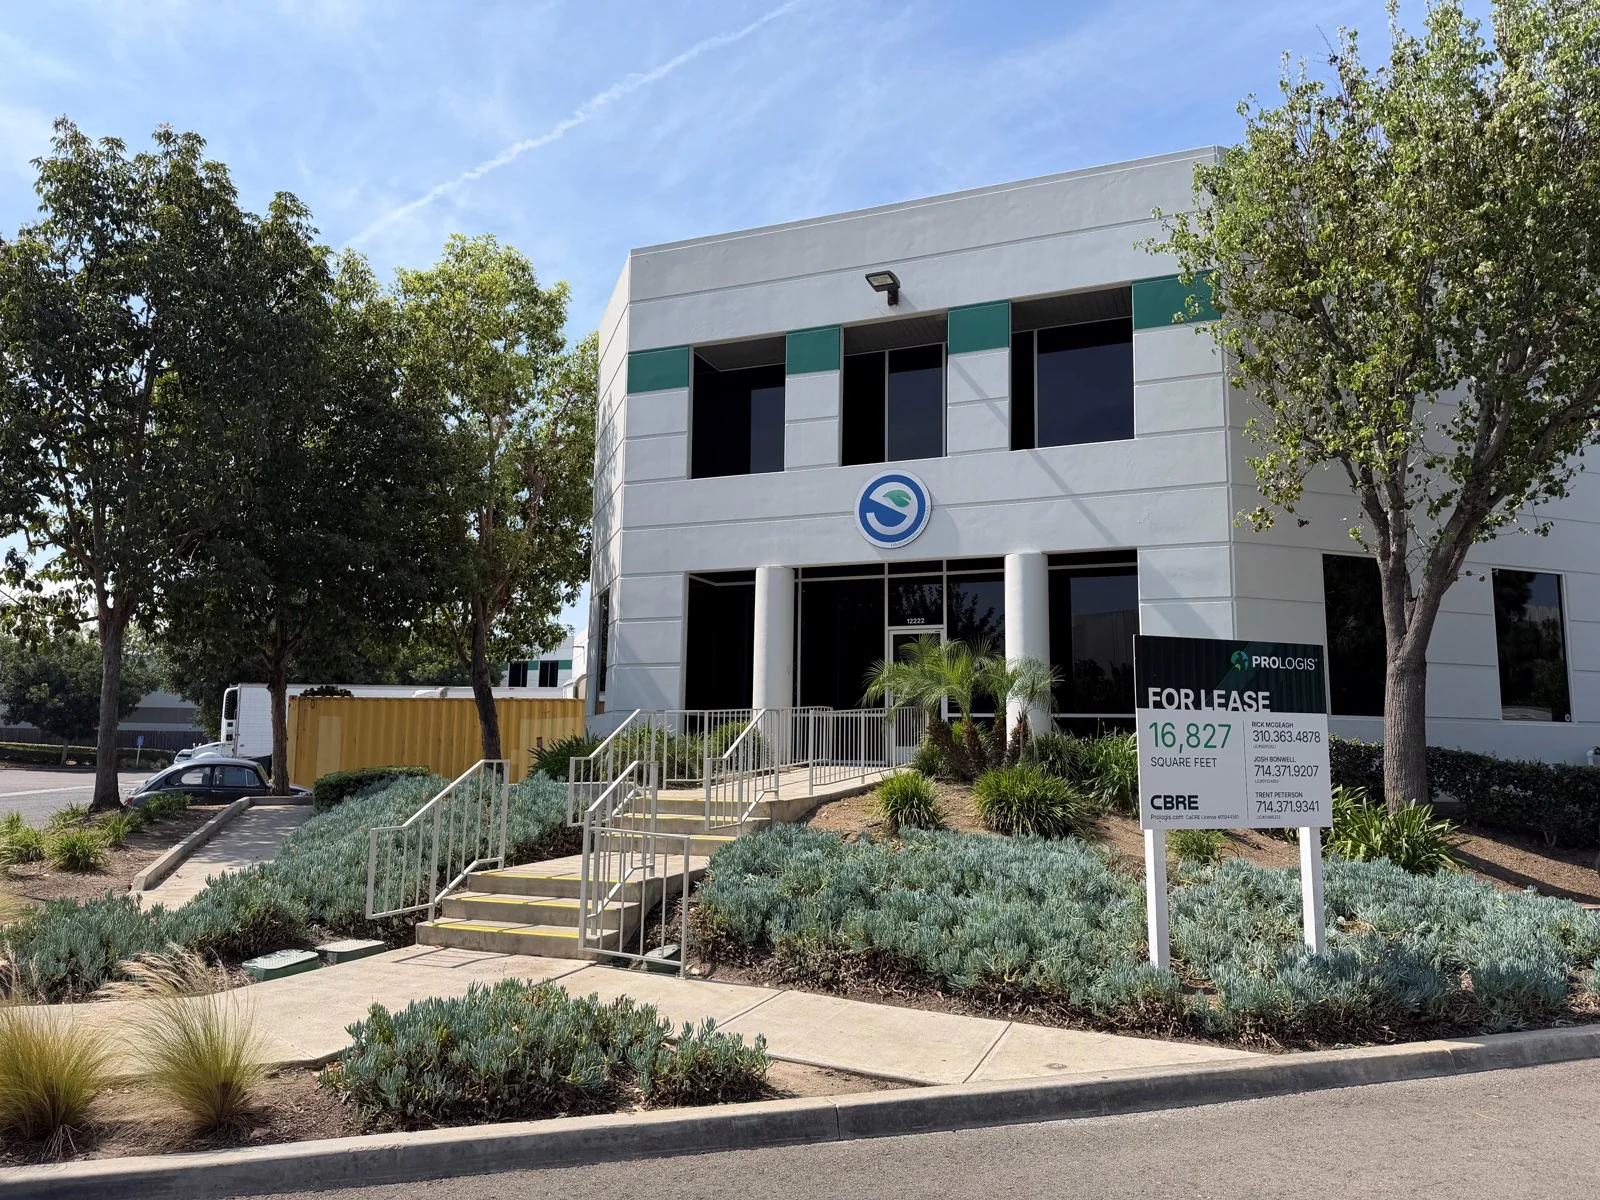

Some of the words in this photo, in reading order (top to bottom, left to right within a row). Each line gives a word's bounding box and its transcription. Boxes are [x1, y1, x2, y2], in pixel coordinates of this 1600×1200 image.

[1252, 655, 1315, 671] PROLOGIS
[1148, 687, 1196, 711] FOR
[1200, 688, 1271, 713] LEASE
[1149, 721, 1232, 754] 16,827
[1252, 729, 1321, 743] 310.363.4878
[1150, 756, 1191, 768] SQUARE
[1194, 757, 1218, 768] FEET
[1253, 764, 1319, 777] 714.371.9207
[1150, 794, 1199, 811] CBRE
[1255, 800, 1320, 813] 714.371.9341
[1150, 814, 1184, 822] Prologis.com
